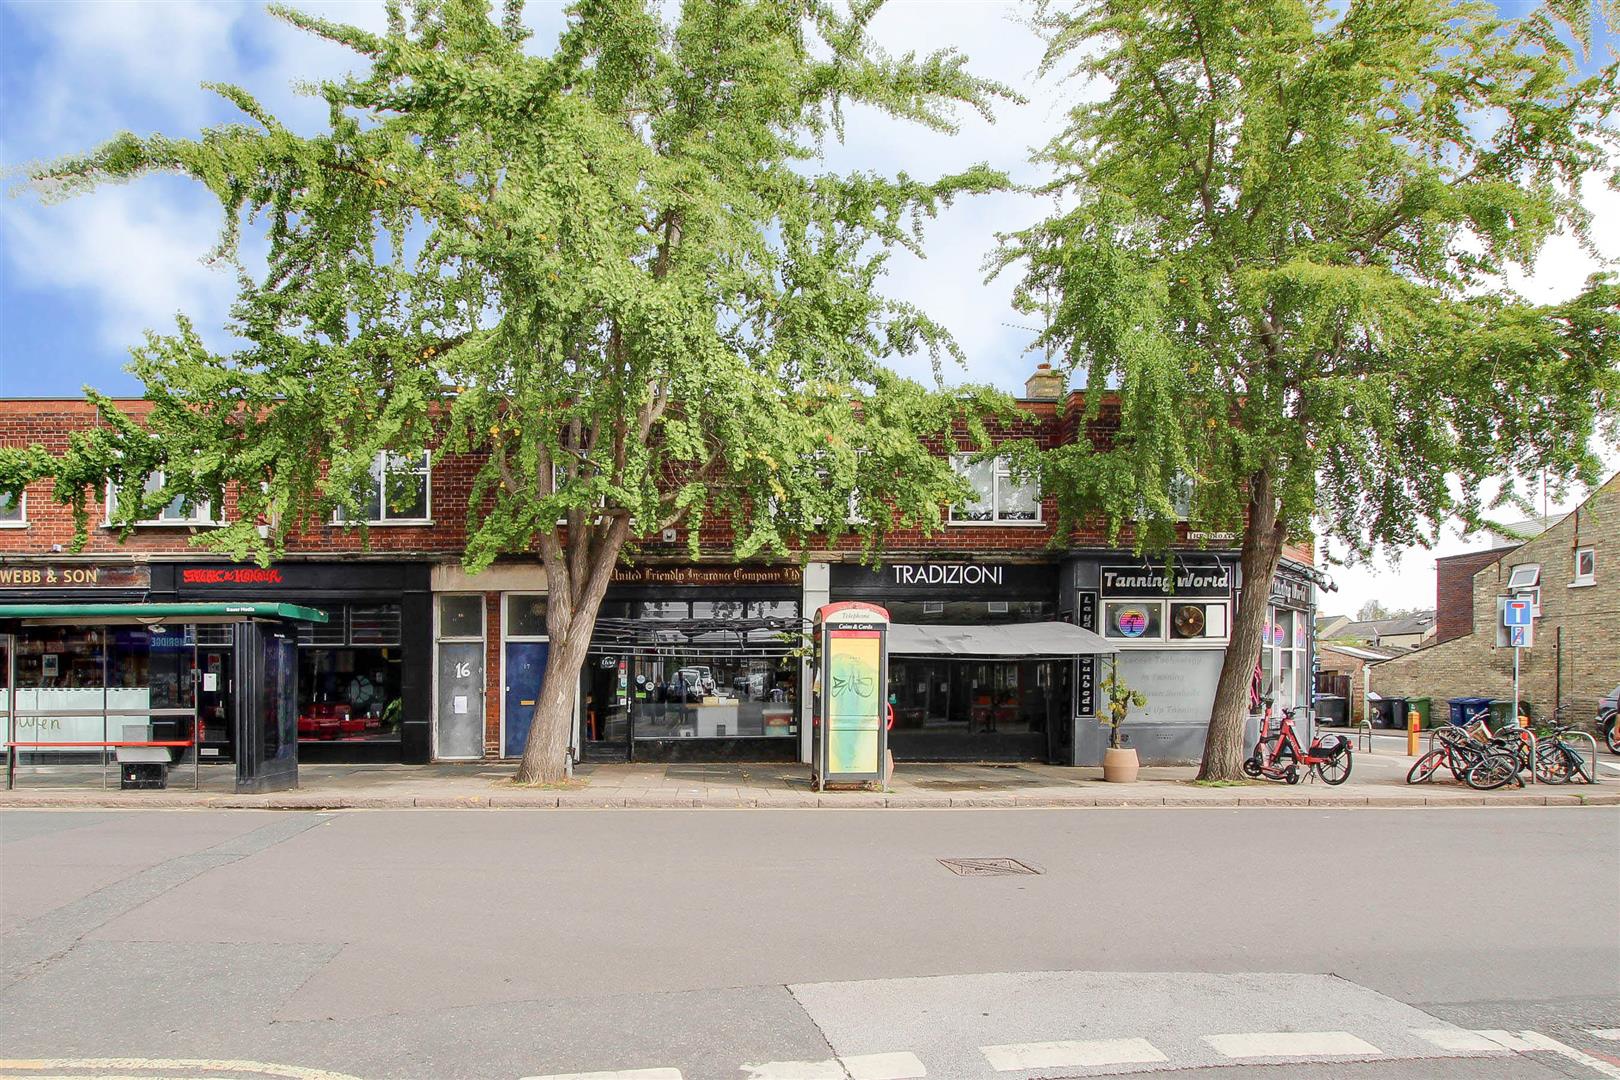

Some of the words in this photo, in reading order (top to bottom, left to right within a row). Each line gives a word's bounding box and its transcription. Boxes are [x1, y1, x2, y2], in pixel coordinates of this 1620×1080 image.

[0, 569, 41, 584] WEBB
[46, 569, 58, 583] &
[63, 569, 97, 583] SON
[645, 568, 684, 584] Friendly
[687, 567, 731, 581] Insurance
[733, 568, 780, 583] Company
[783, 567, 800, 581] Ltd
[892, 565, 1002, 585] TRADIZIONI
[1104, 572, 1171, 592] Tanning
[1177, 572, 1229, 588] World
[455, 662, 471, 679] 16
